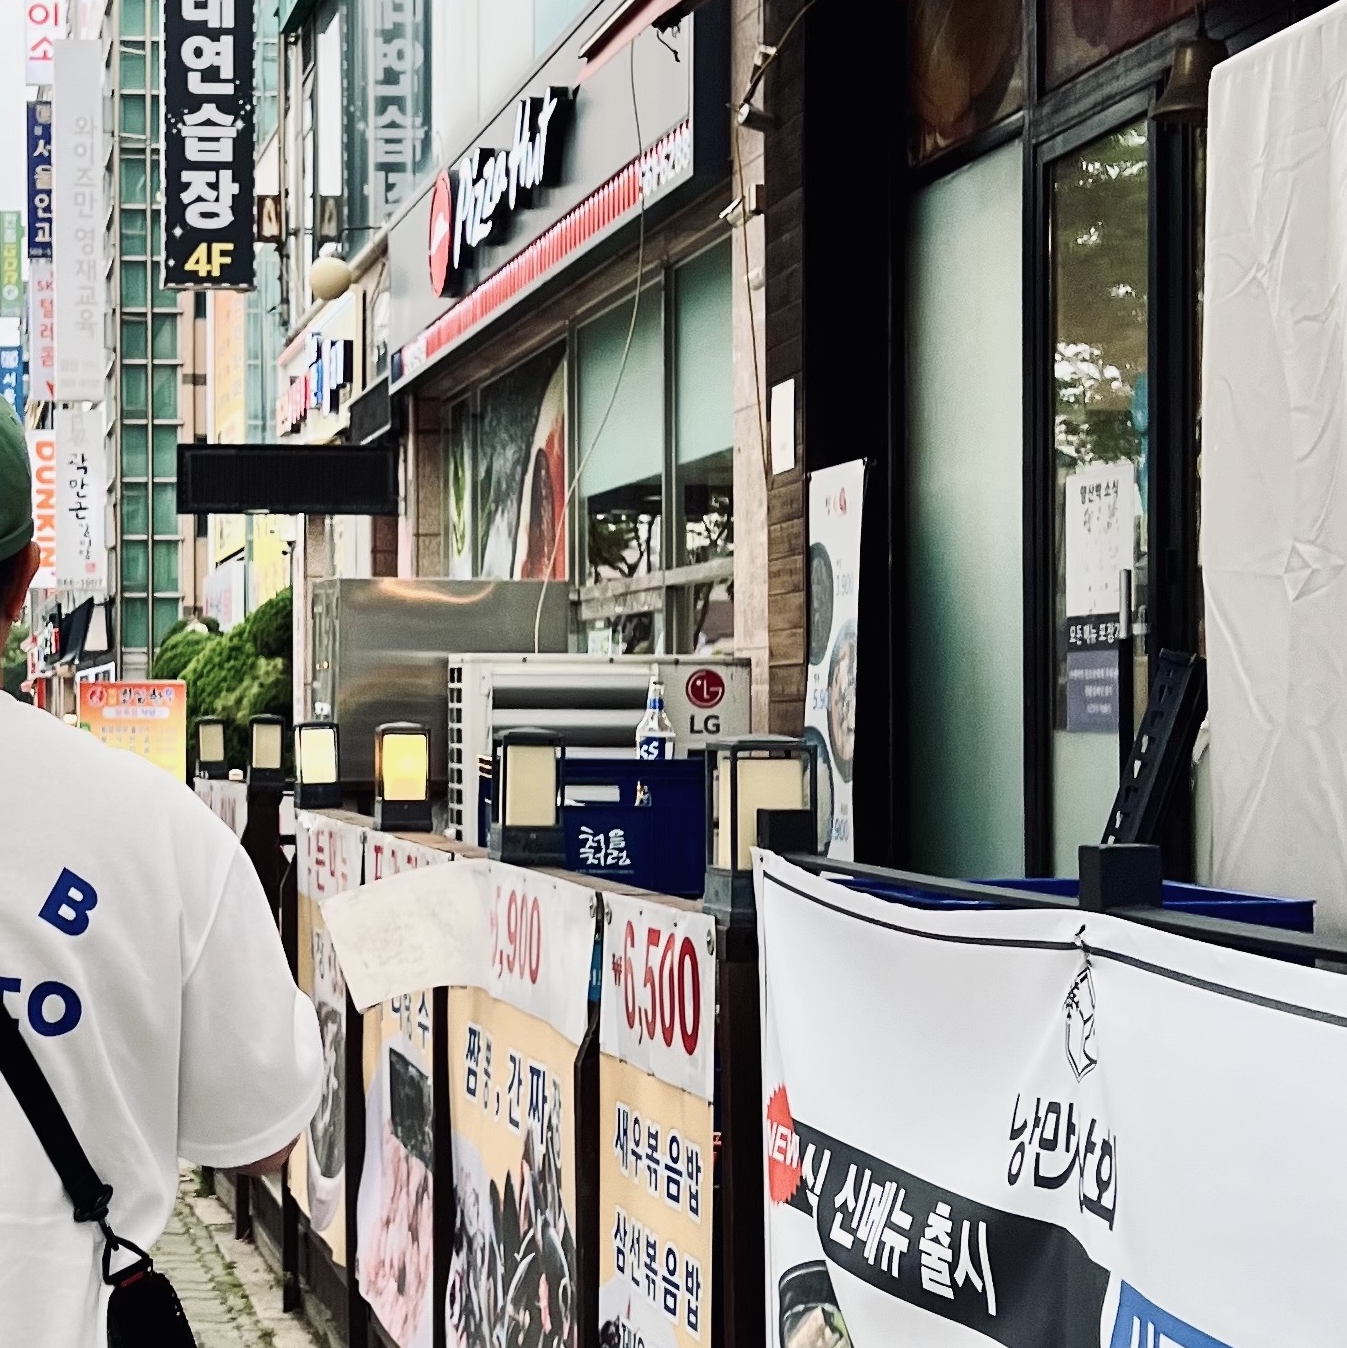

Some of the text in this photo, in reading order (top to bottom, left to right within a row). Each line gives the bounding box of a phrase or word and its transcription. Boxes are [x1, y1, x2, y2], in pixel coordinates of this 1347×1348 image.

[74, 228, 98, 338] 영재교육
[184, 242, 235, 277] 4F
[35, 441, 57, 567] DUNKIN
[689, 714, 721, 735] LG
[615, 1107, 702, 1218] 새우볶음밥
[614, 1211, 701, 1334] 삼선볶음밥
[829, 1162, 914, 1279] 신메뉴
[918, 1201, 997, 1317] 출시
